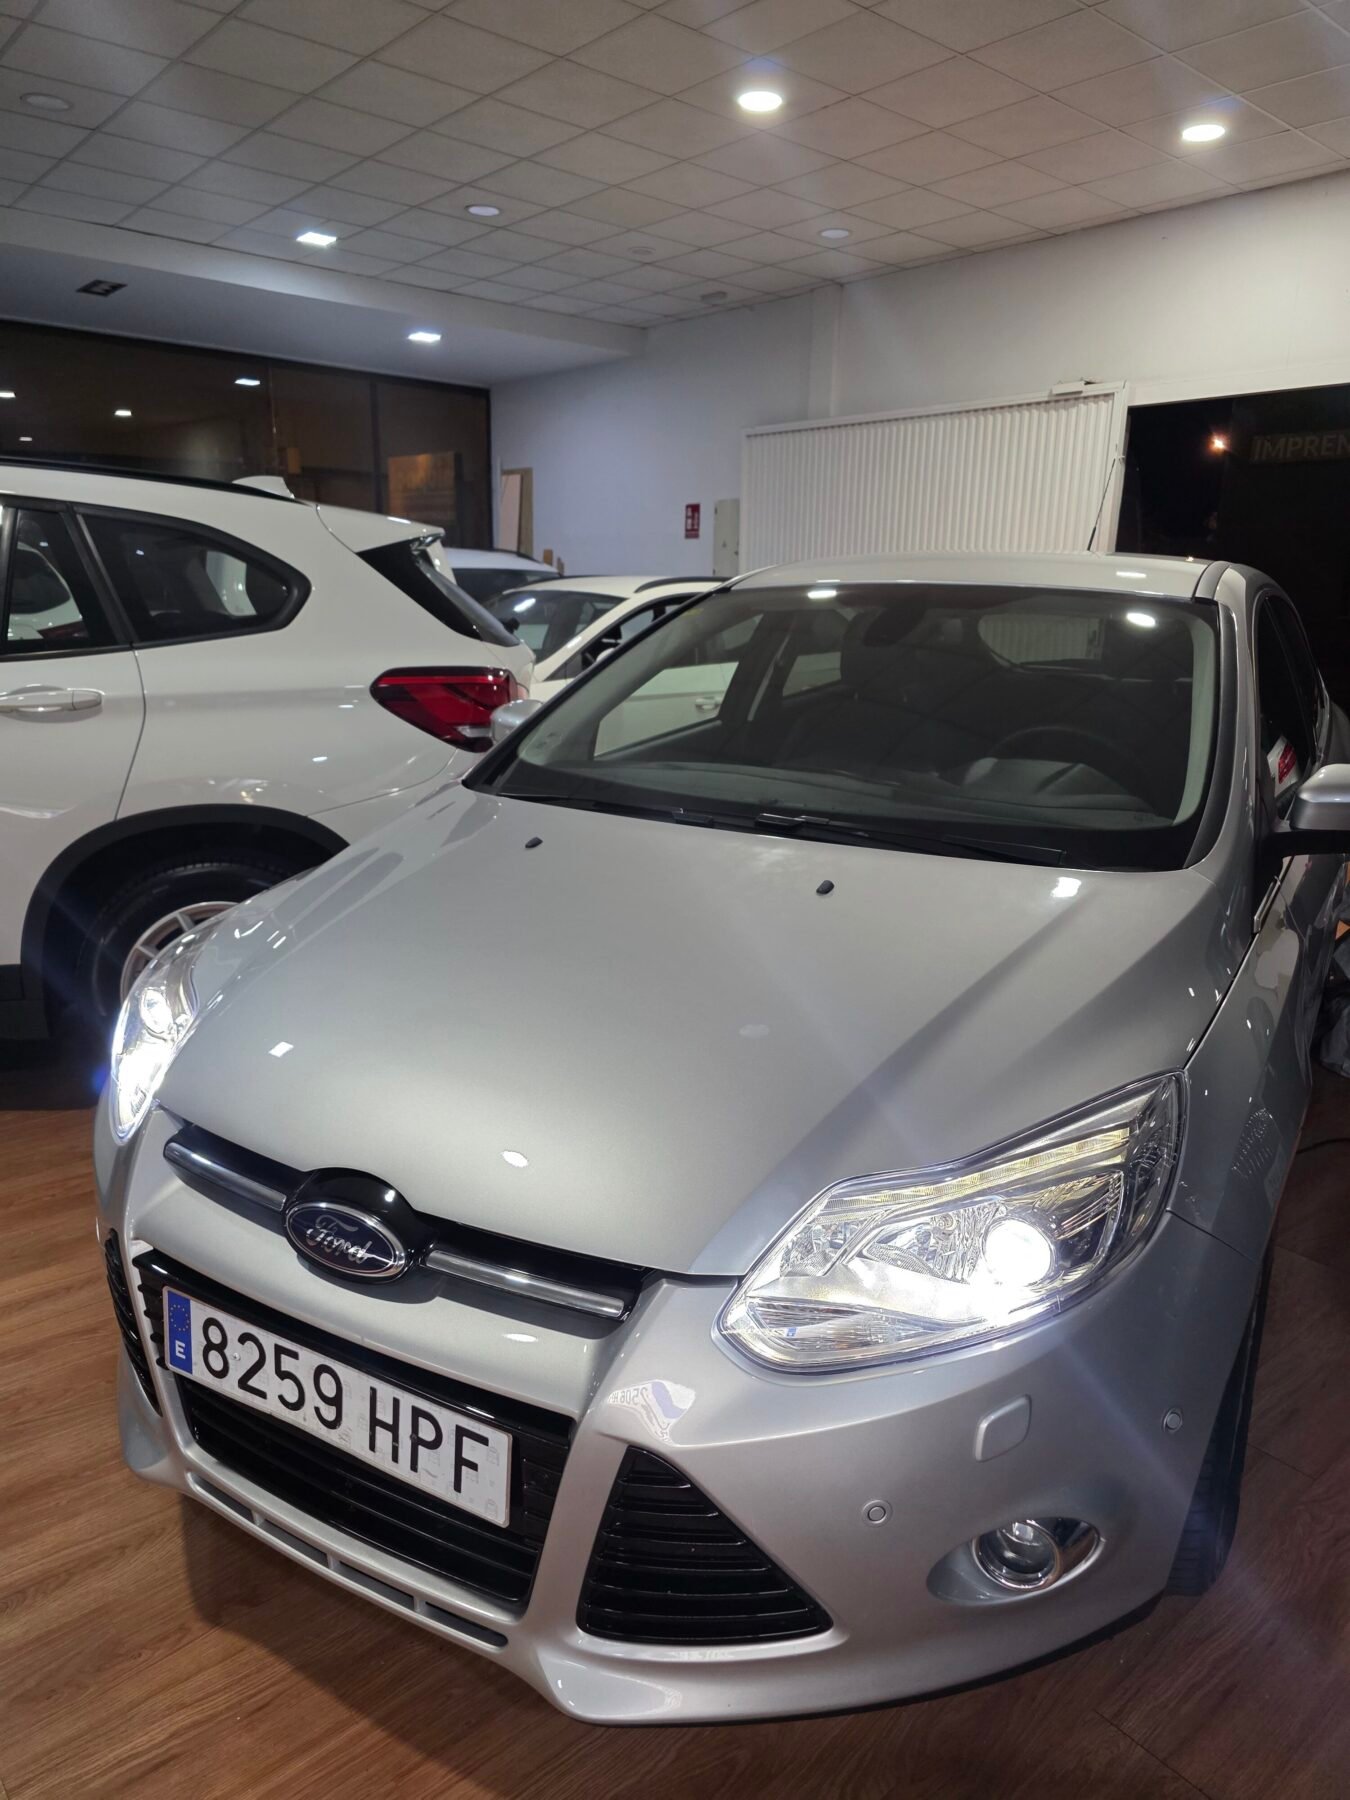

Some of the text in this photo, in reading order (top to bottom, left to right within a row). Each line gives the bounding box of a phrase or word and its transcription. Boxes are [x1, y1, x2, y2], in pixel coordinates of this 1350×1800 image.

[306, 1214, 373, 1264] Ford
[175, 1339, 187, 1360] E
[202, 1317, 489, 1493] 8259 HPF
